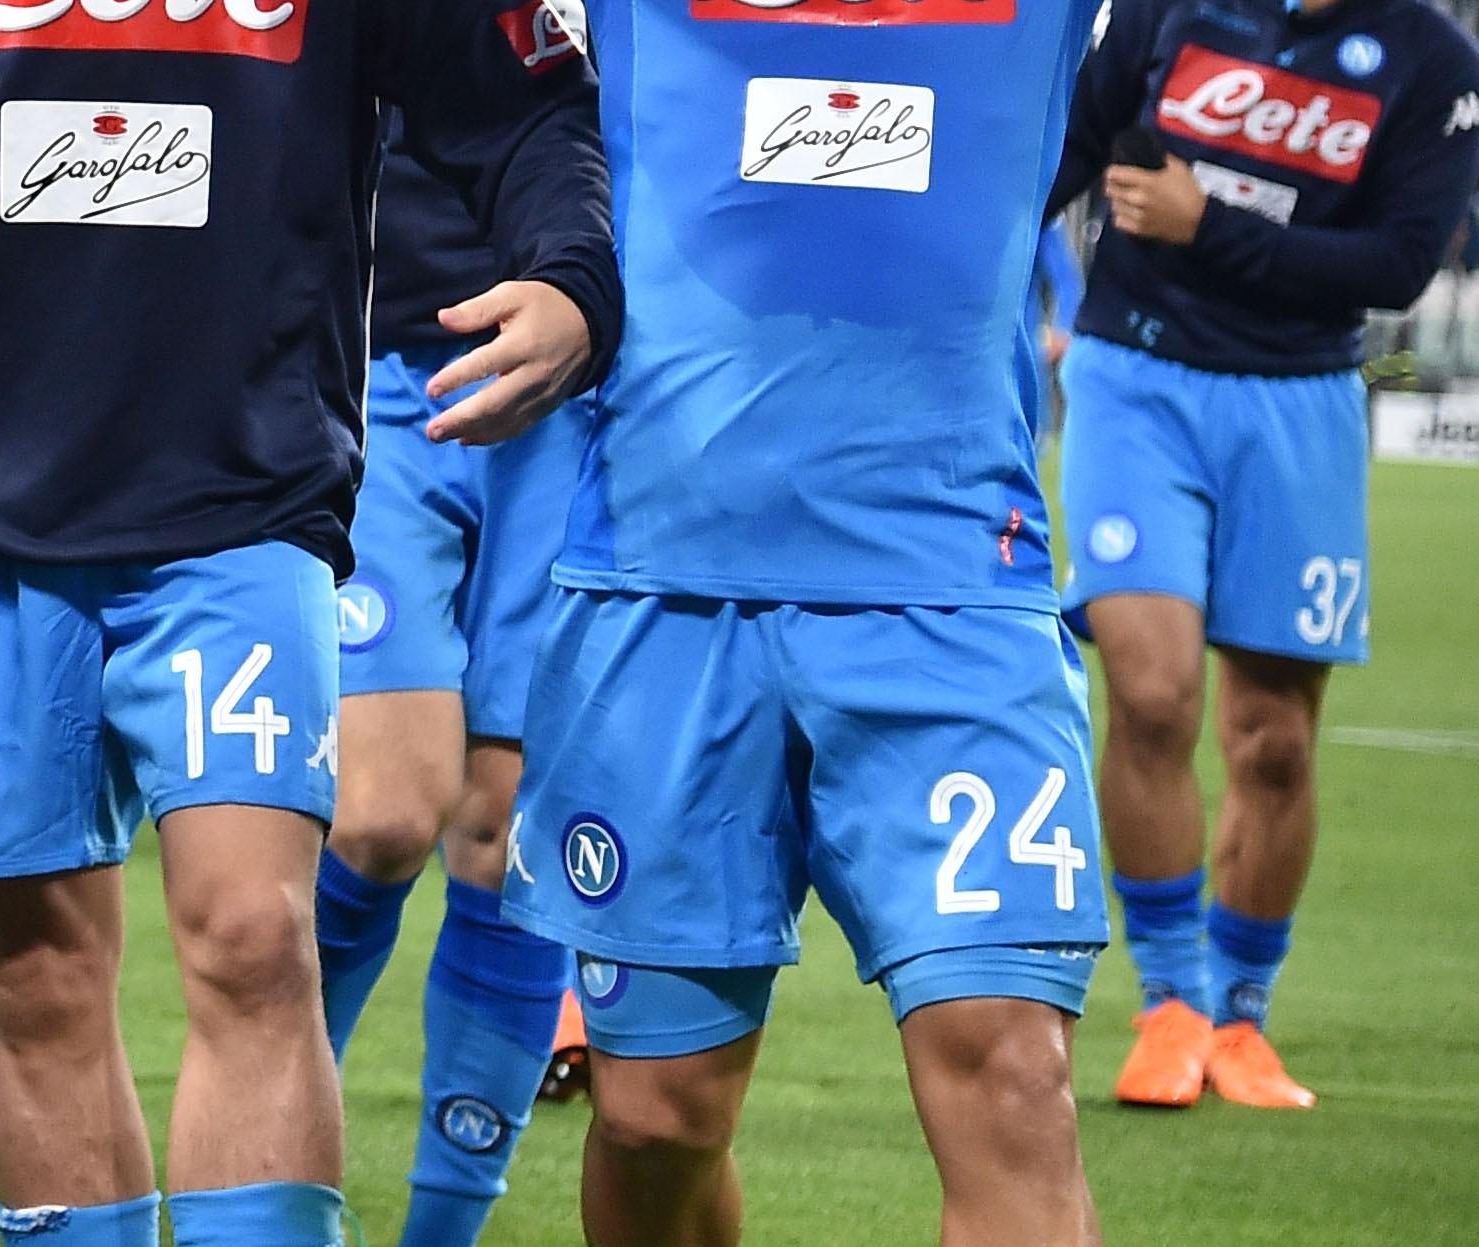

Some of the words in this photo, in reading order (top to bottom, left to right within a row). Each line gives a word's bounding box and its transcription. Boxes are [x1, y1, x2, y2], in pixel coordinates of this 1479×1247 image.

[744, 99, 930, 180] Garofalo
[1160, 68, 1370, 166] Lete
[4, 121, 209, 219] Garofalo
[1296, 556, 1363, 645] 37
[172, 643, 289, 780] 14
[573, 839, 610, 877] N
[930, 768, 1086, 915] 24
